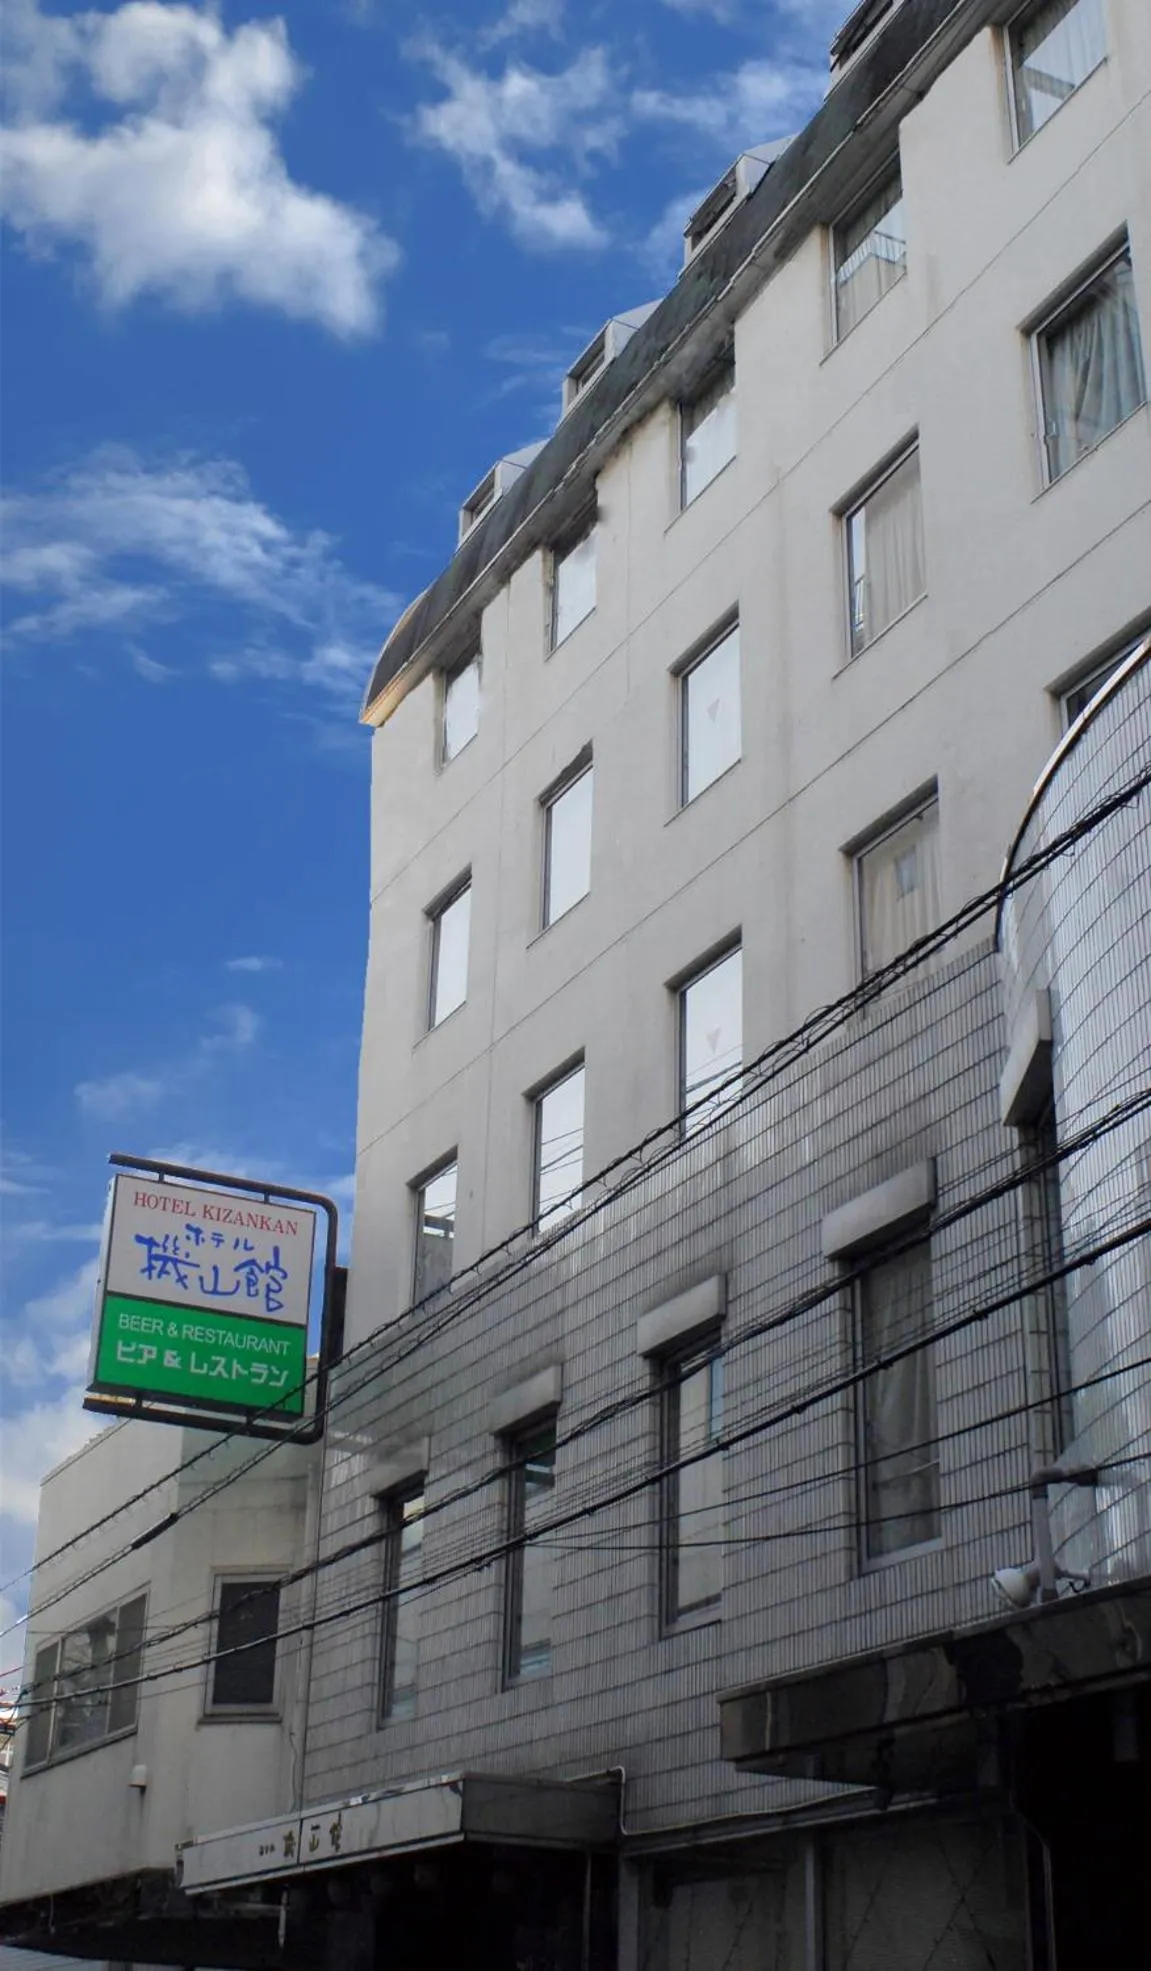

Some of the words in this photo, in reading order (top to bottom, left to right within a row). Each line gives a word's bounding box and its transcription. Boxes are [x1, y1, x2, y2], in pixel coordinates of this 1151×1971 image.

[133, 1191, 196, 1217] HOTEL
[202, 1204, 299, 1236] KIZANKAN
[185, 1223, 255, 1251] ホテル
[119, 1313, 163, 1336] BEER
[167, 1322, 179, 1338] &
[182, 1324, 290, 1356] RESTAURANT
[190, 1353, 289, 1387] レストラン
